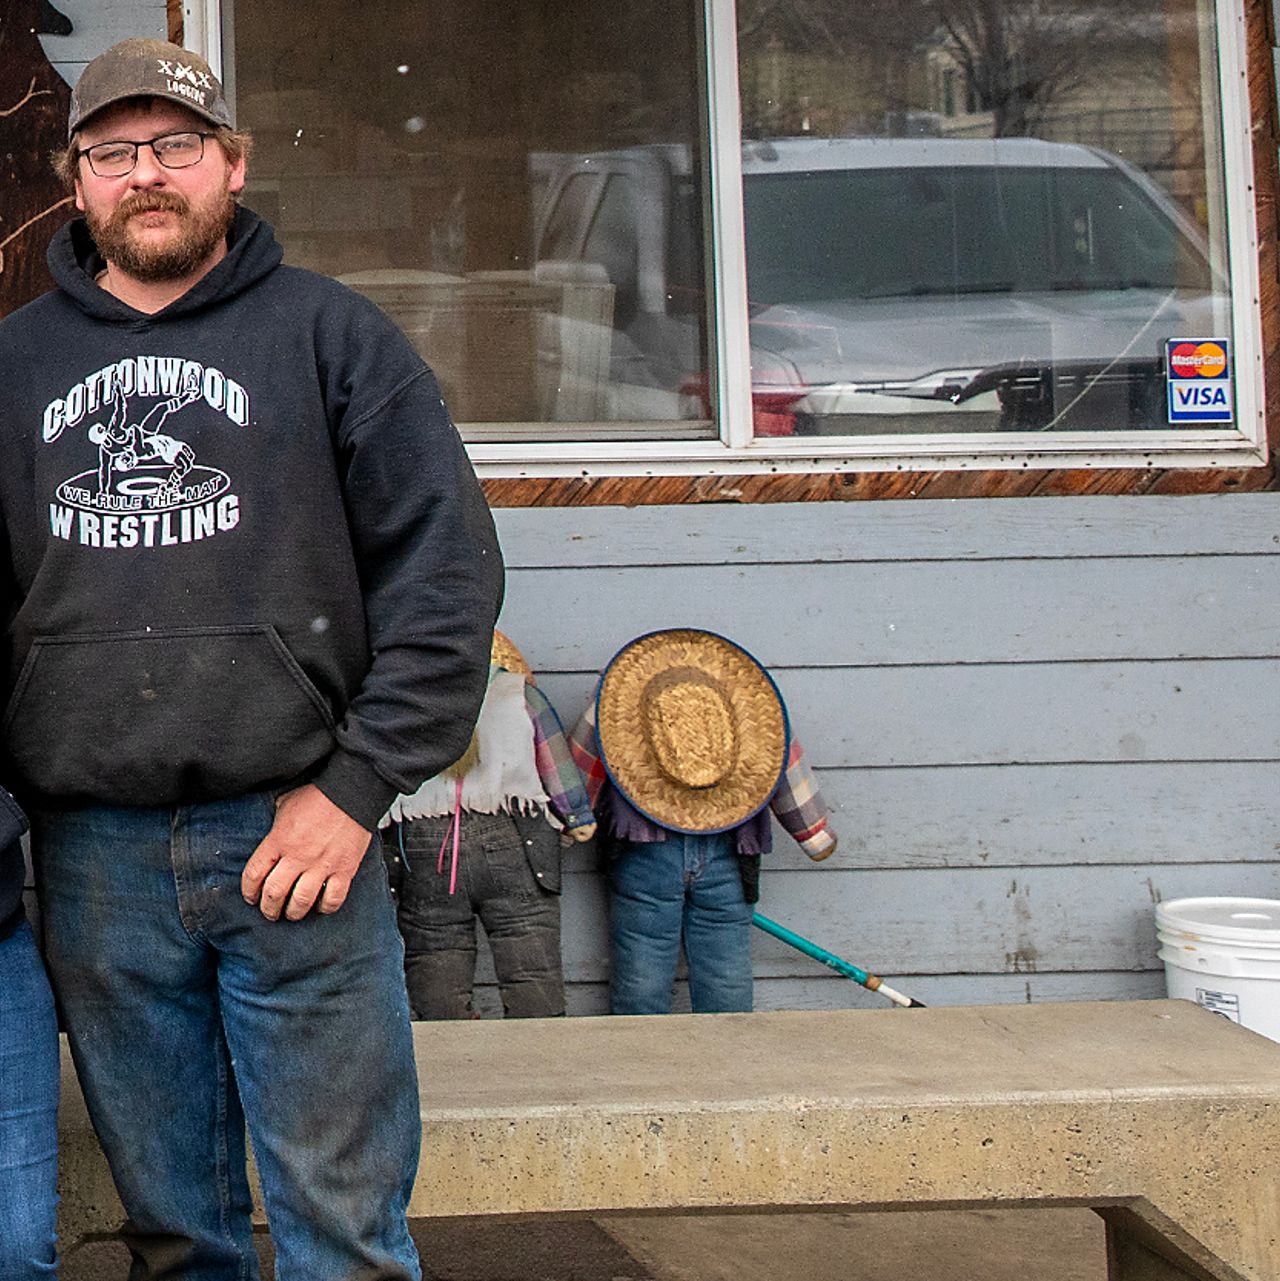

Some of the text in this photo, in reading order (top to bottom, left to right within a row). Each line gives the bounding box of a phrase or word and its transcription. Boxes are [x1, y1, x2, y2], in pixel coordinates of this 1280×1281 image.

[43, 355, 249, 443] COTTONWOOD
[1176, 387, 1226, 405] VISA
[50, 494, 240, 549] WRESTLING
